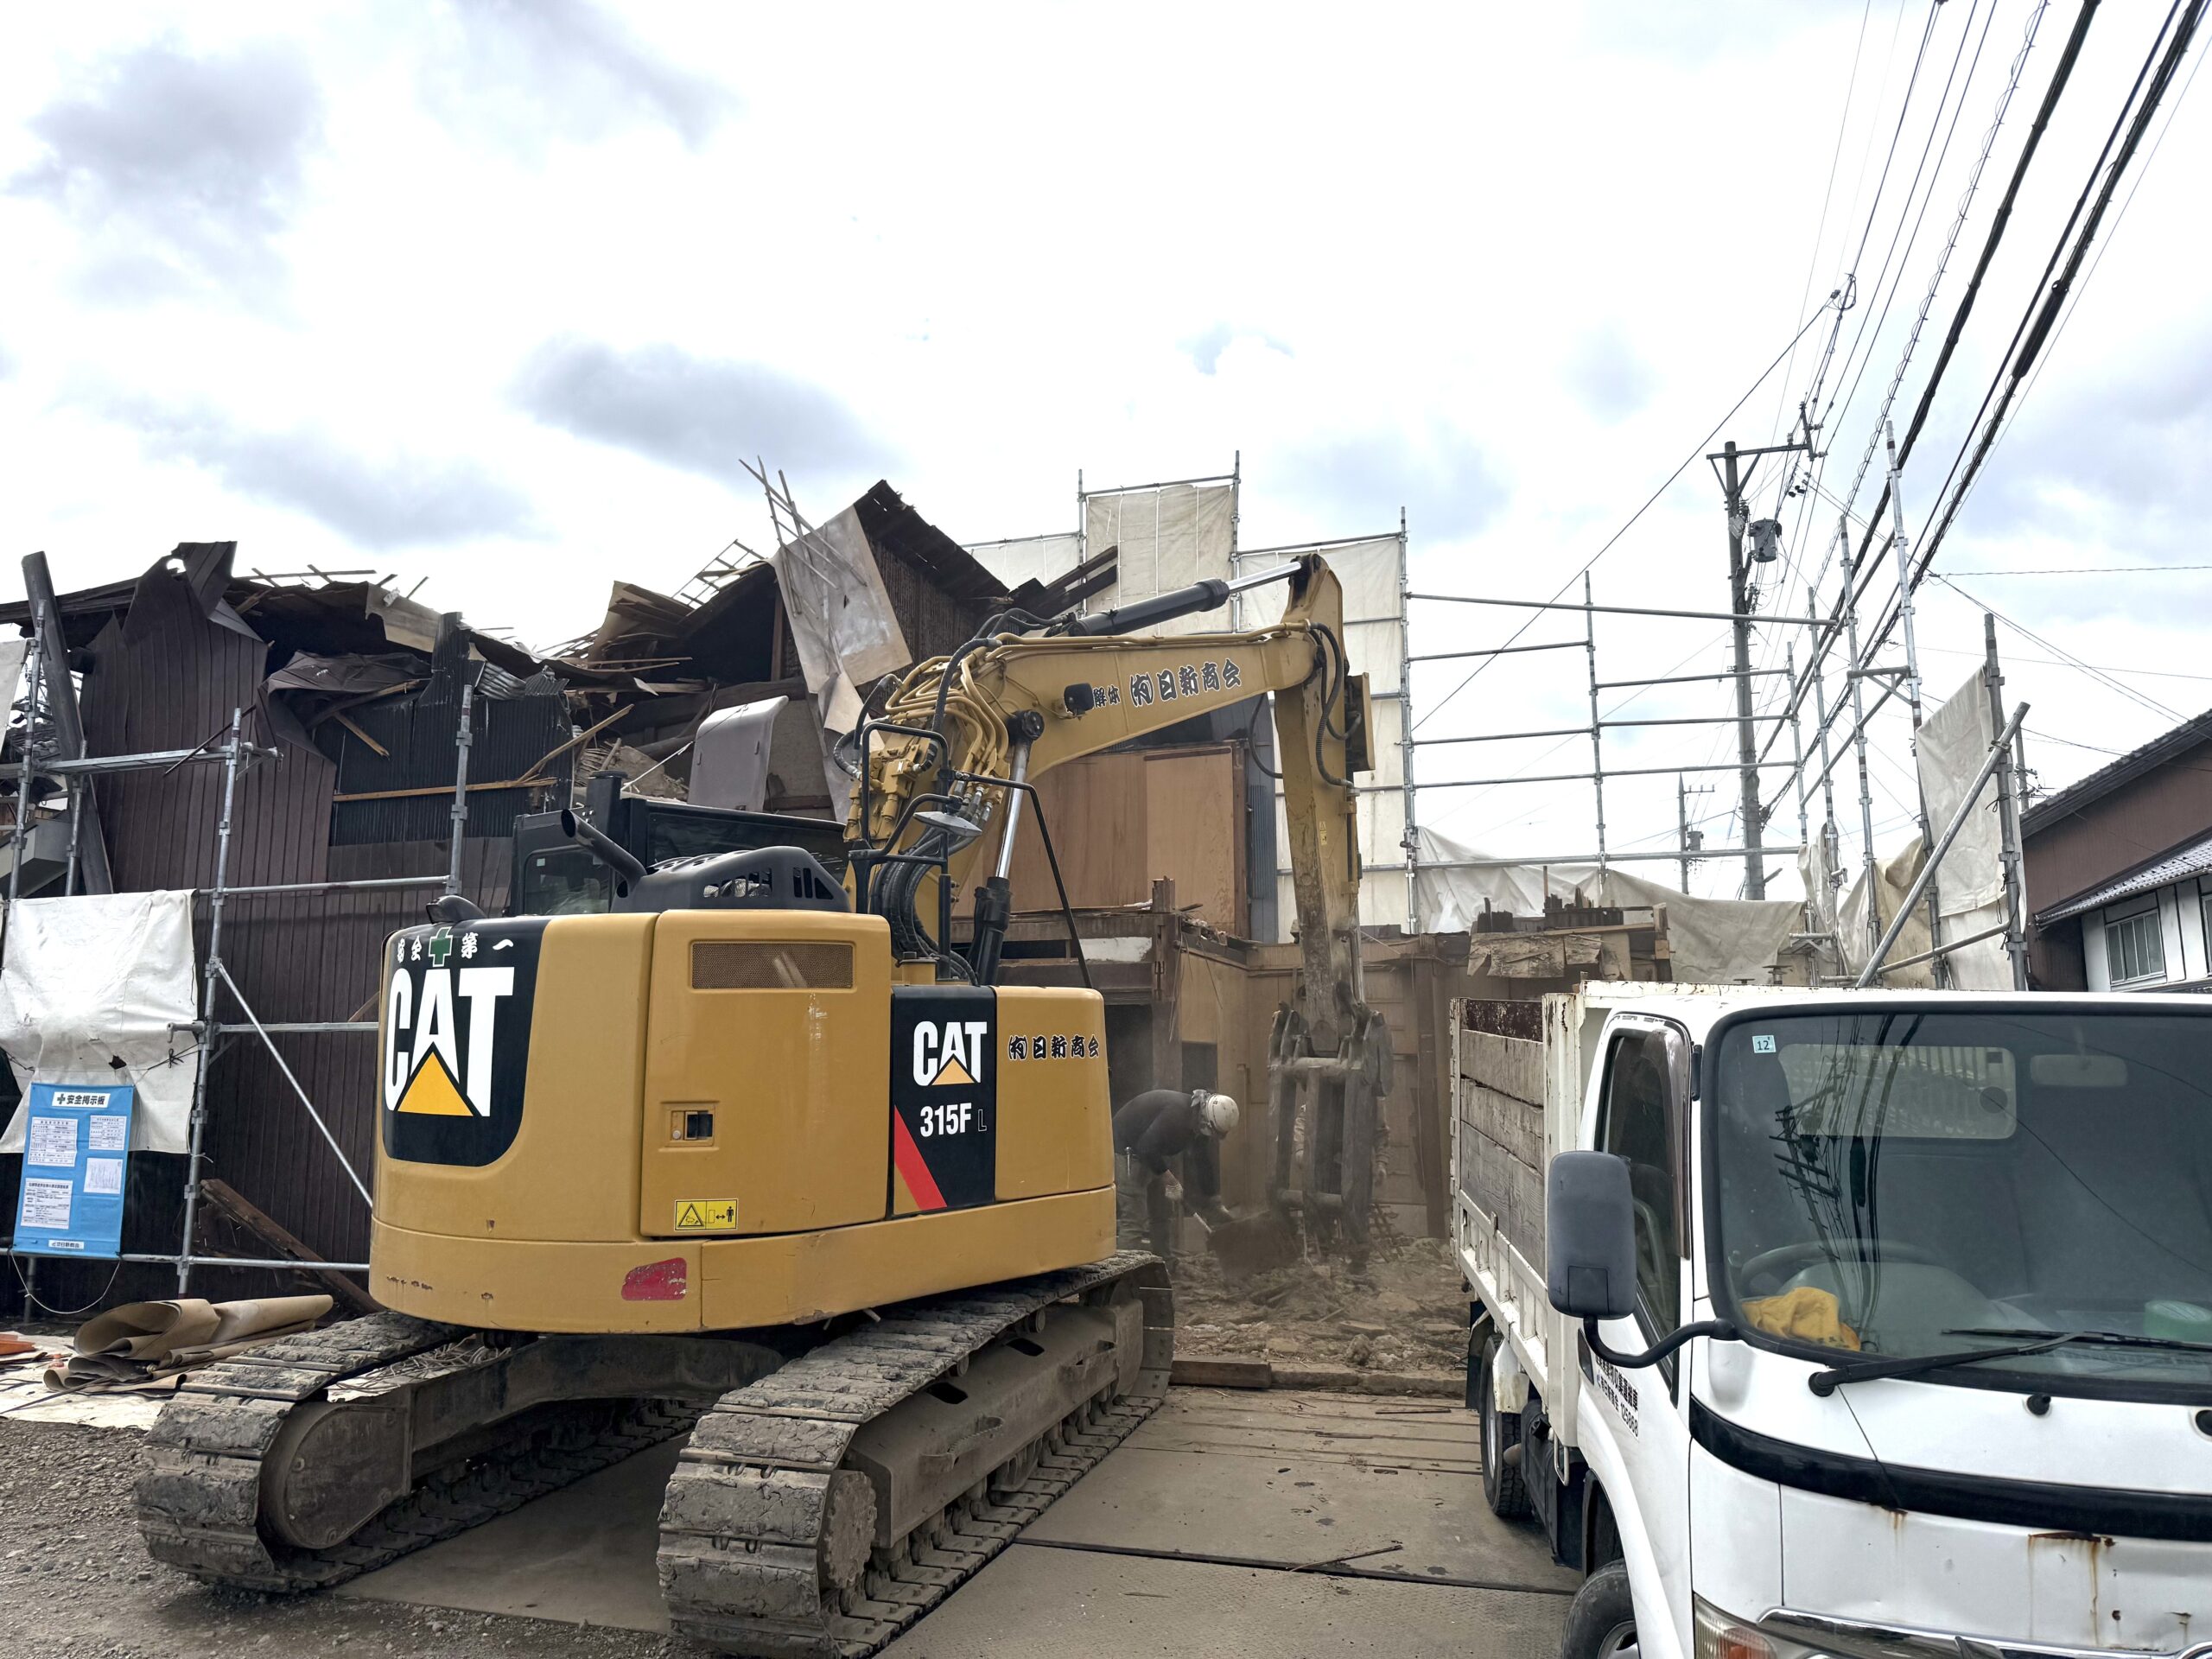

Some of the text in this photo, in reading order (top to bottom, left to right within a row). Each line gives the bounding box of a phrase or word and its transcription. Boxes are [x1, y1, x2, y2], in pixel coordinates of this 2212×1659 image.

[385, 966, 515, 1117] CAT
[912, 1020, 988, 1086] CAT
[67, 1094, 105, 1105] 安全掲示板
[919, 1103, 988, 1137] 315F L
